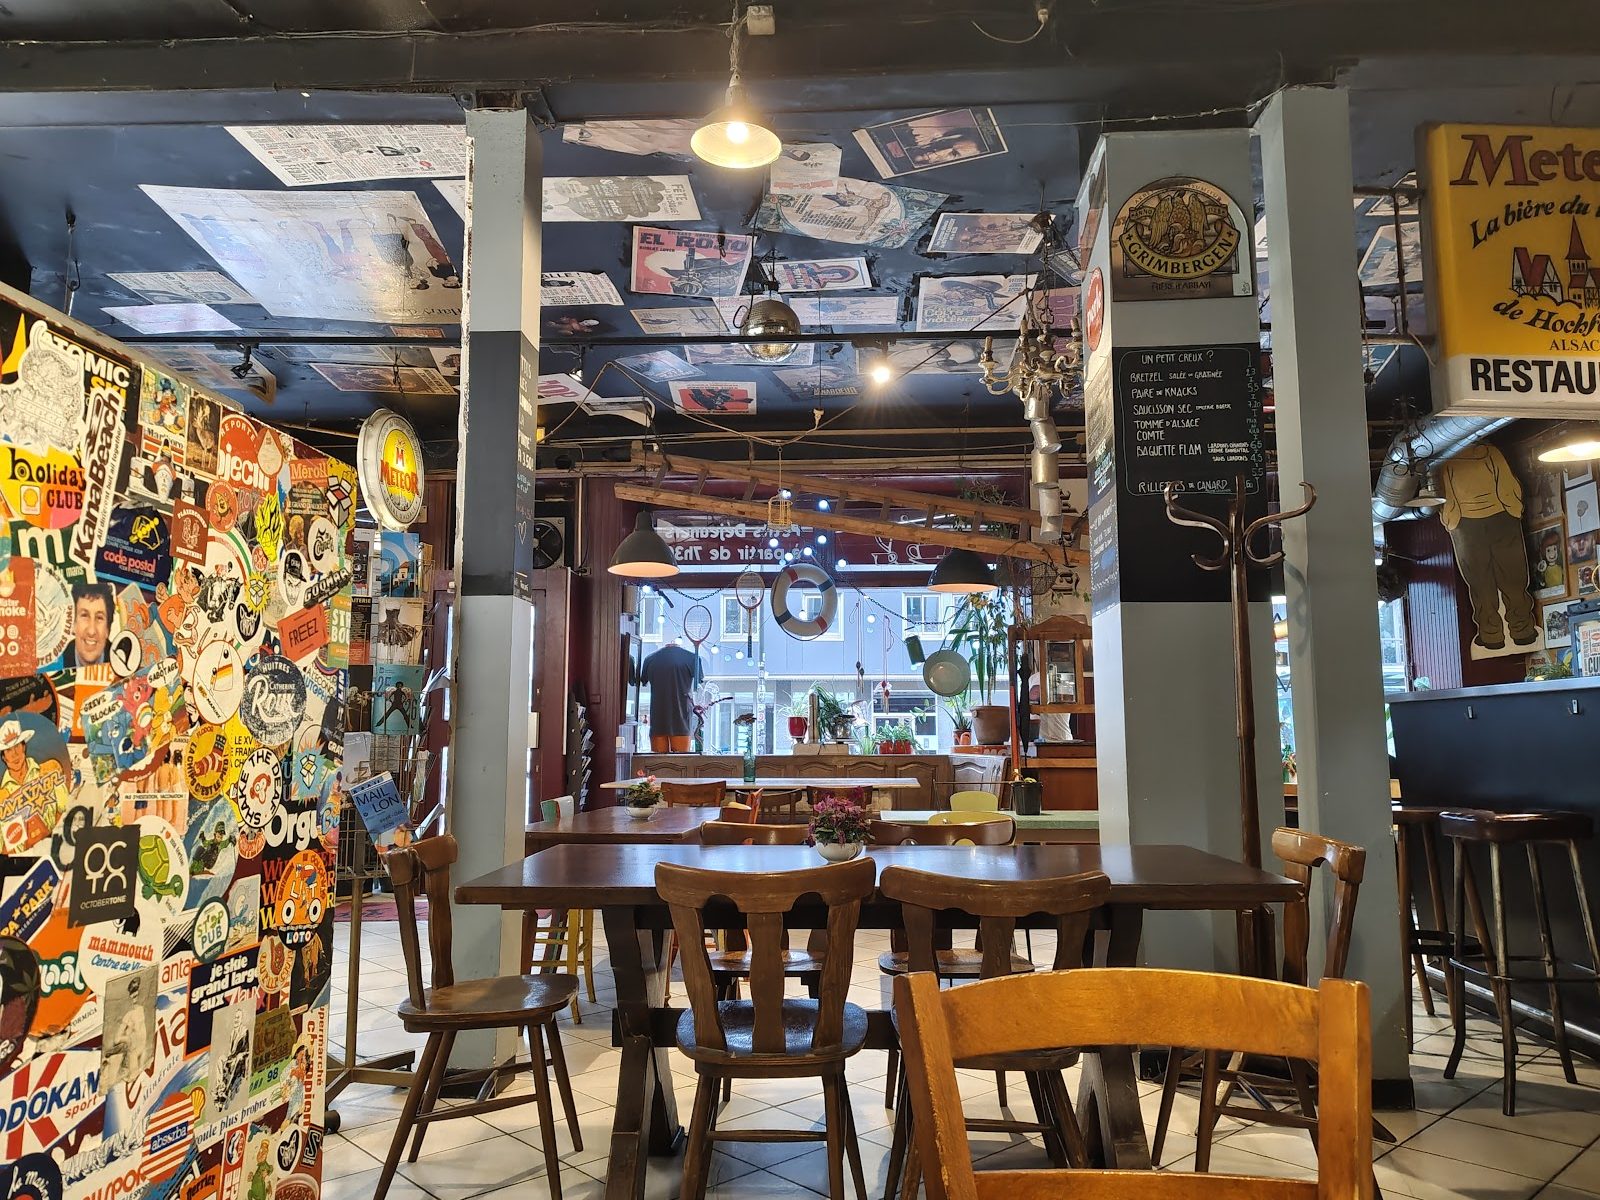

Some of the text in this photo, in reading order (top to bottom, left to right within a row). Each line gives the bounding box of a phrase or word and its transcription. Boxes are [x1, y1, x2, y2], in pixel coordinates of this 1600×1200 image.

[1470, 194, 1590, 249] La bière du
[640, 233, 748, 252] EL ROO
[1128, 237, 1234, 275] GRIMBERGEN
[1492, 299, 1600, 337] de Hochf
[1141, 354, 1154, 364] UN
[1155, 353, 1176, 364] PETIT
[1178, 352, 1203, 363] CREUX
[1130, 372, 1165, 383] BRETZEL
[1131, 388, 1155, 399] PAIRE
[1164, 386, 1198, 397] KNACKS
[1133, 404, 1175, 416] SAUCISSON
[1177, 404, 1193, 414] SEC
[1133, 419, 1165, 430] TOMME
[1136, 443, 1202, 457] BAGUETTE FLAM
[8, 447, 86, 491] holiday
[74, 392, 121, 564] KanaBeach
[380, 459, 420, 496] METEOR
[1138, 481, 1186, 493] RILLETES
[1197, 480, 1228, 492] CANARD
[46, 488, 83, 510] CLUB
[104, 550, 127, 565] code
[128, 555, 156, 573] postal
[239, 749, 281, 825] THE DEAF SHAKE
[356, 787, 391, 807] MAIL
[372, 794, 400, 813] LON
[21, 880, 54, 919] PARK
[80, 894, 127, 910] OCTOBERTONE
[200, 925, 223, 950] PUB
[286, 930, 312, 944] LOTO
[88, 935, 154, 962] mammouth
[91, 953, 120, 970] Centre
[120, 958, 131, 970] de
[210, 963, 224, 983] je
[223, 954, 248, 975] skie
[190, 973, 230, 1005] grand
[200, 993, 225, 1013] aux
[267, 1067, 279, 1083] 98
[65, 1094, 98, 1119] sport
[220, 1114, 238, 1136] plus
[241, 1097, 267, 1120] propre
